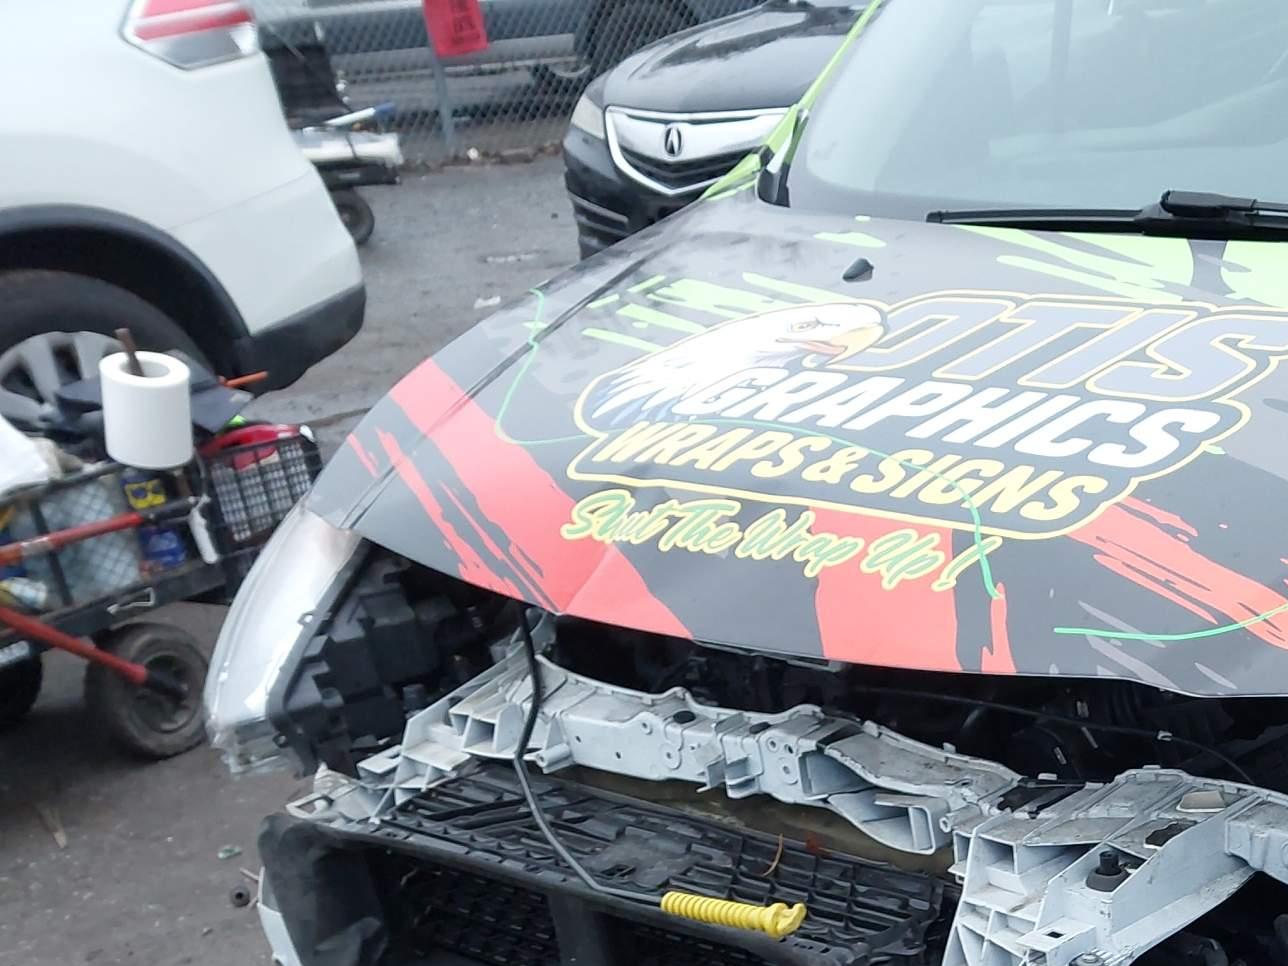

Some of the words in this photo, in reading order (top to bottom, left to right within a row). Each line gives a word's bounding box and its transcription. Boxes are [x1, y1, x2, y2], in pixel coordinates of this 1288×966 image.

[671, 367, 1222, 468] GRAPHICS
[592, 421, 832, 478] WRAPS
[849, 449, 1108, 521] SIGNS
[658, 499, 744, 554] The
[734, 508, 865, 578] Wrap
